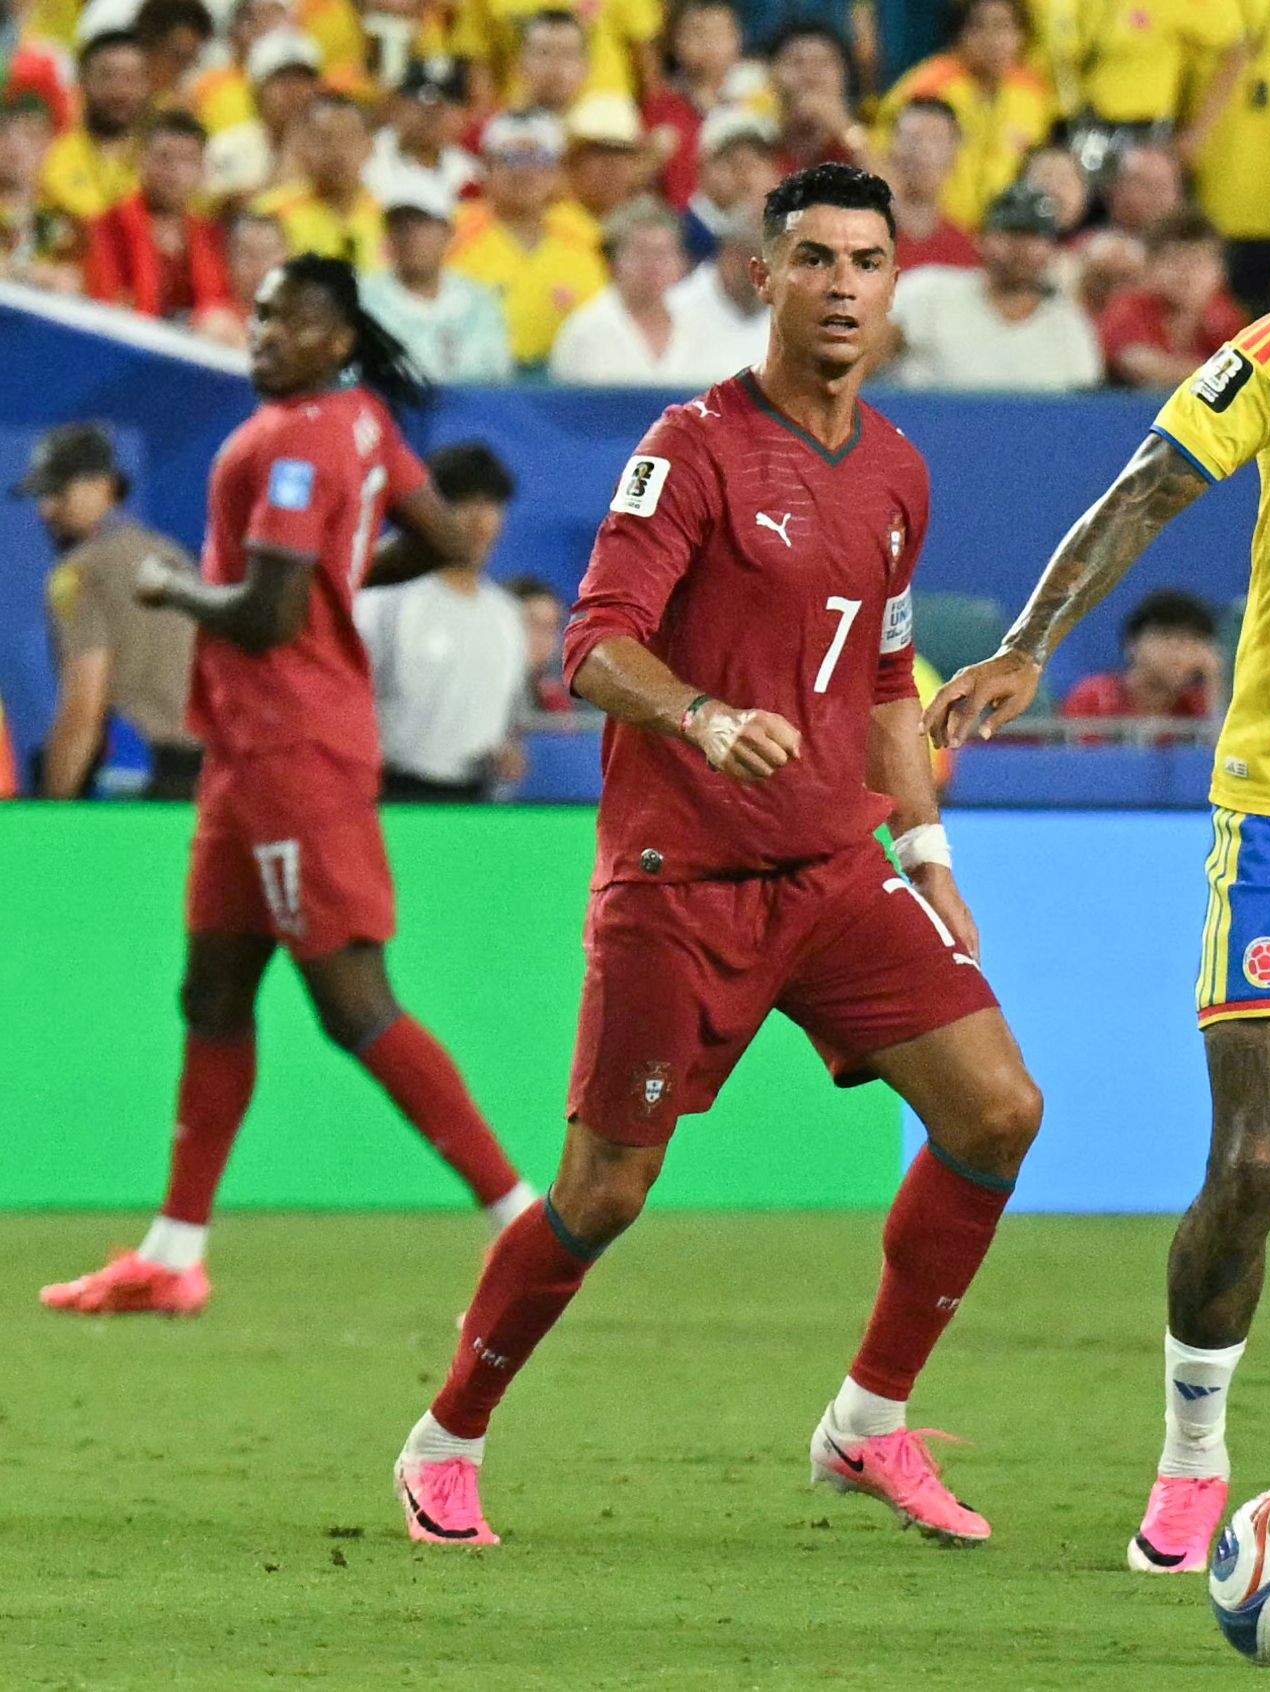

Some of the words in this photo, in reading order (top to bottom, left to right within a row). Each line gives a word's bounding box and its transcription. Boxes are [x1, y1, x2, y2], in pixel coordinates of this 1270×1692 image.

[813, 596, 862, 693] 7
[252, 839, 300, 912] 17
[882, 877, 955, 947] 7
